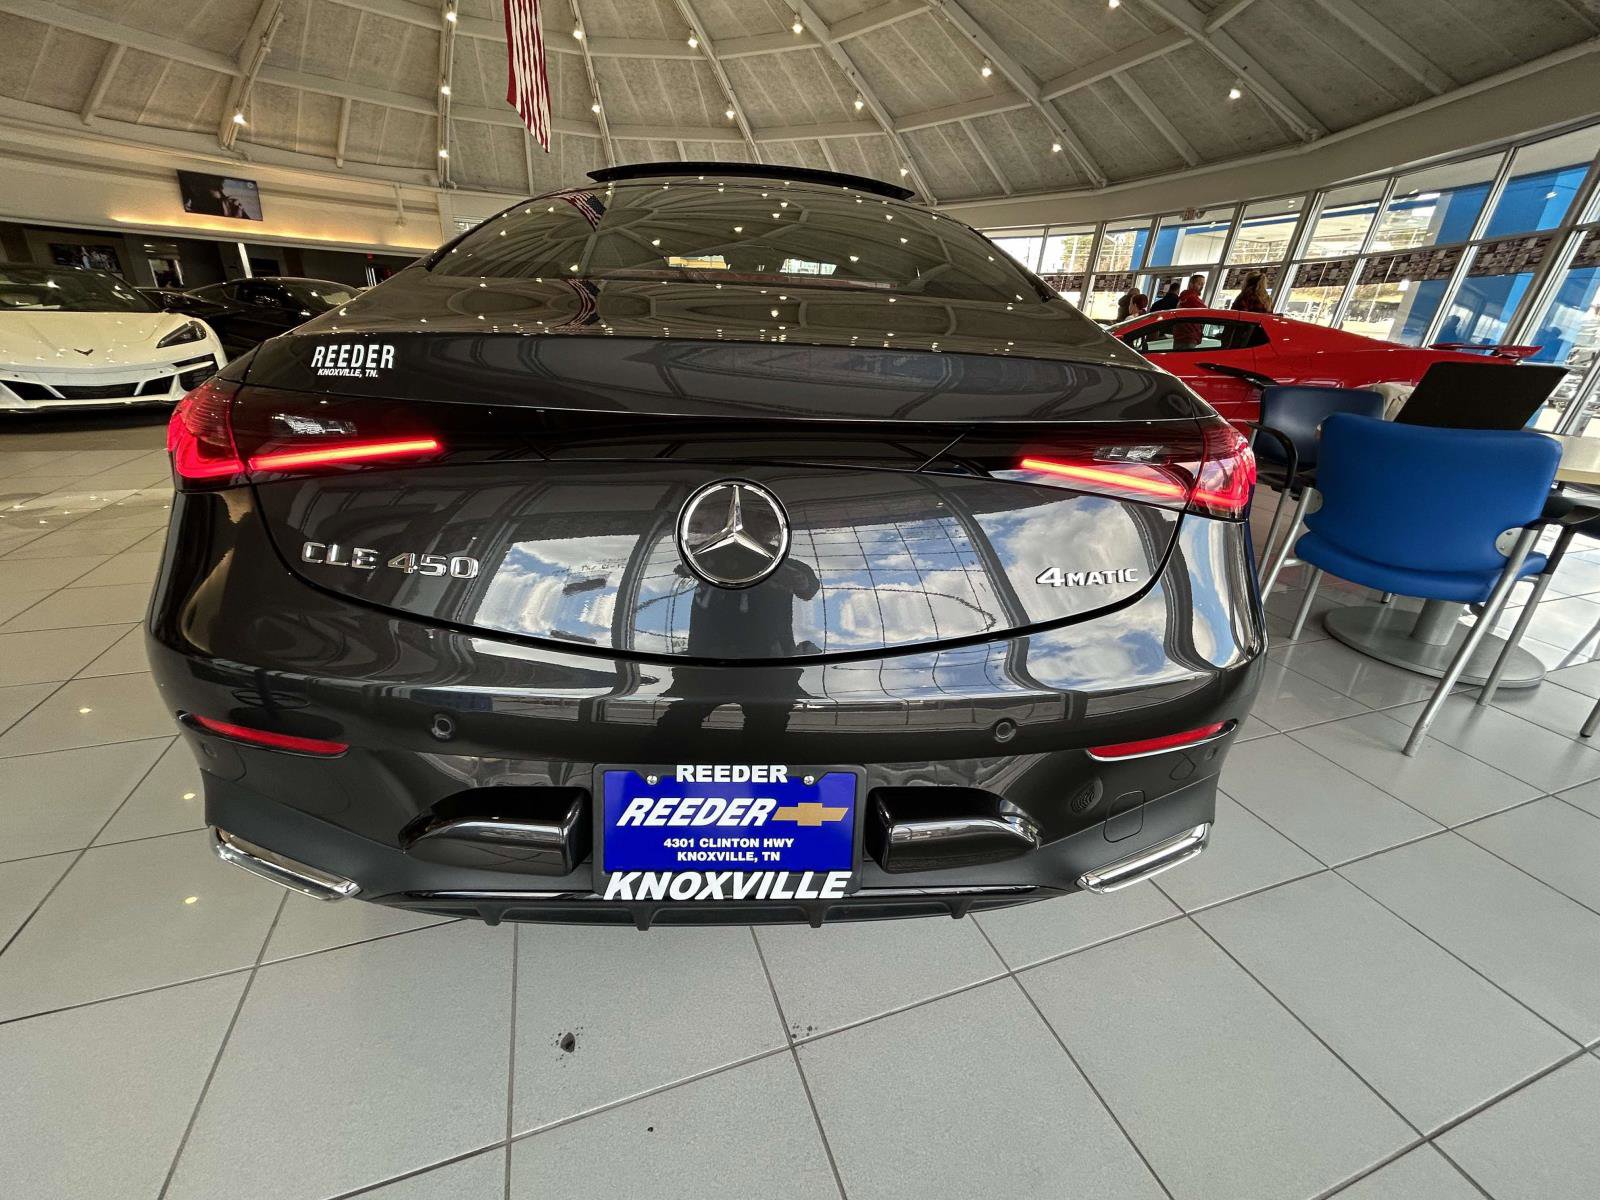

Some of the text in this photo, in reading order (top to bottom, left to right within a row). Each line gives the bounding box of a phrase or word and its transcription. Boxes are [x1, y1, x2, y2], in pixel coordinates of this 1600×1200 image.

[310, 344, 395, 369] REEDER
[317, 368, 379, 378] KNOXVILLE, TN.
[302, 541, 479, 579] CLE 450
[1036, 567, 1138, 587] 4MATIC
[676, 764, 788, 784] REEDER
[616, 798, 777, 826] REEDER
[663, 838, 795, 848] 4301 CLINTON HWY
[677, 851, 781, 863] KNOXVILLE, TN
[603, 871, 852, 901] KNOXVILLE
